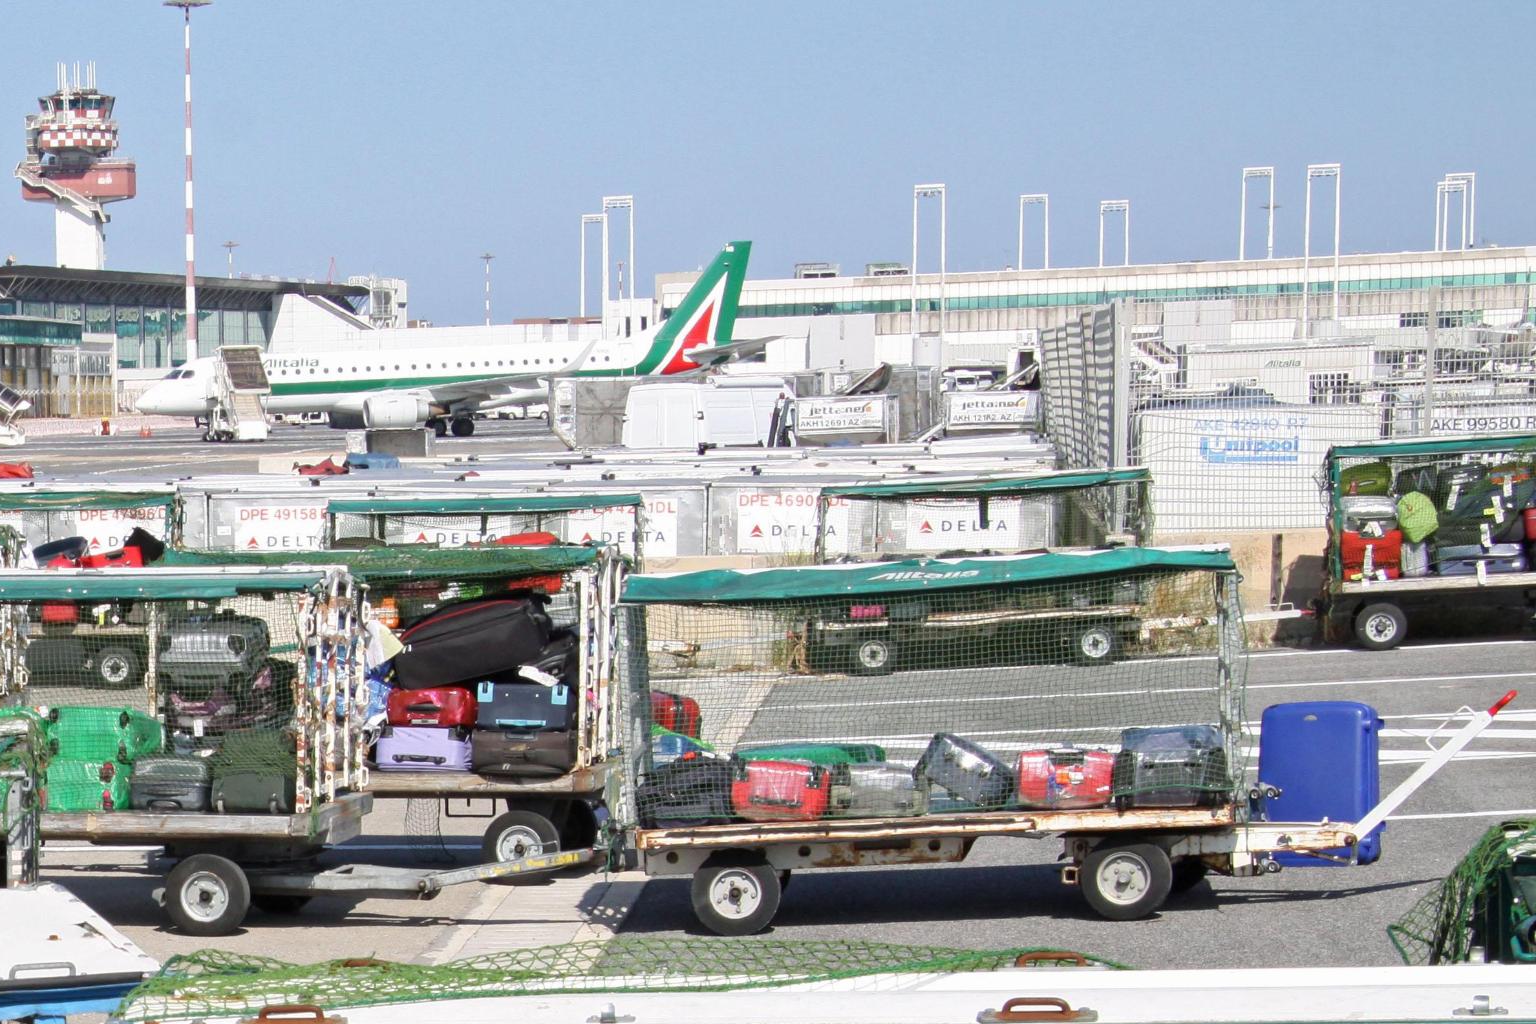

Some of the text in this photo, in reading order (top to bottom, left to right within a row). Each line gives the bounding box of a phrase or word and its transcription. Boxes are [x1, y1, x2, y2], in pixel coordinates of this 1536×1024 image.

[1264, 359, 1302, 368] Alitalia
[1431, 419, 1463, 431] AKE
[1467, 416, 1521, 430] 99580
[739, 494, 769, 507] DPE
[80, 509, 108, 521] DPE
[240, 509, 269, 521] DPE
[274, 508, 317, 520] 49158
[771, 524, 837, 537] DLA
[941, 519, 1008, 532] DELA
[602, 531, 666, 544] DETA
[867, 569, 980, 582] Alitalia
